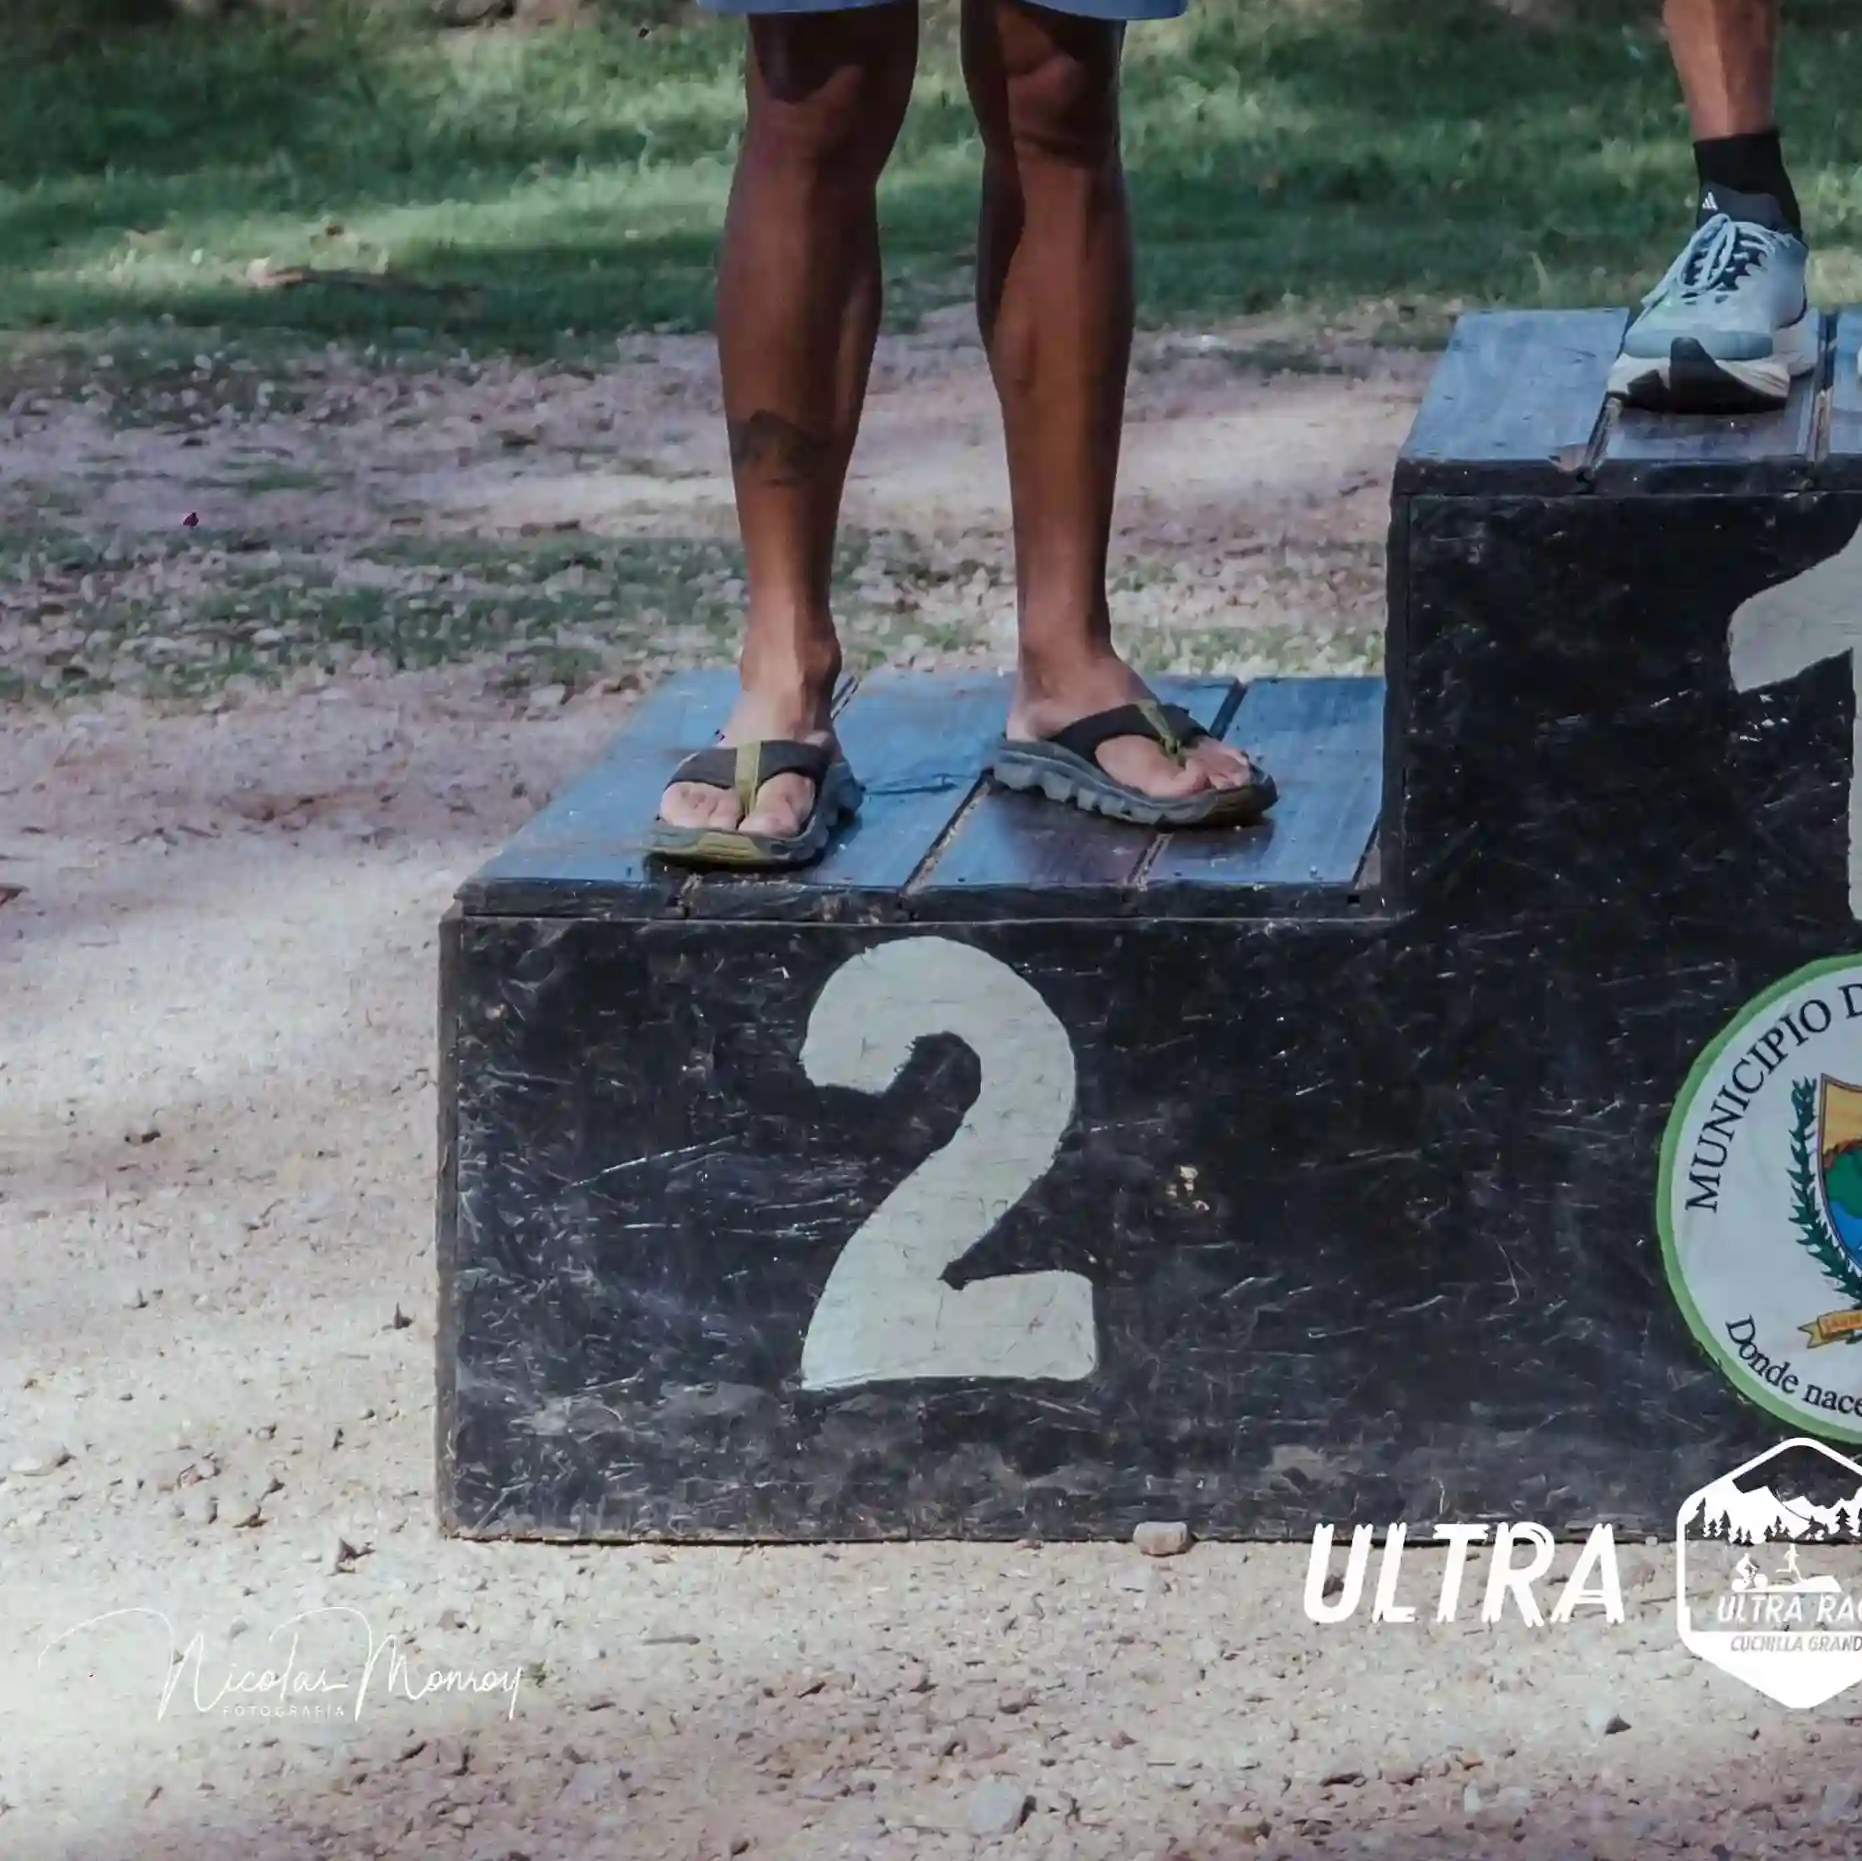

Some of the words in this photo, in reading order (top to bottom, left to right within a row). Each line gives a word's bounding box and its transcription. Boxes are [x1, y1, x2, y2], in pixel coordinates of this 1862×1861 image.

[800, 936, 1096, 1390] 2
[1684, 999, 1833, 1214] MUNICIPIO
[1724, 1314, 1800, 1395] Donde
